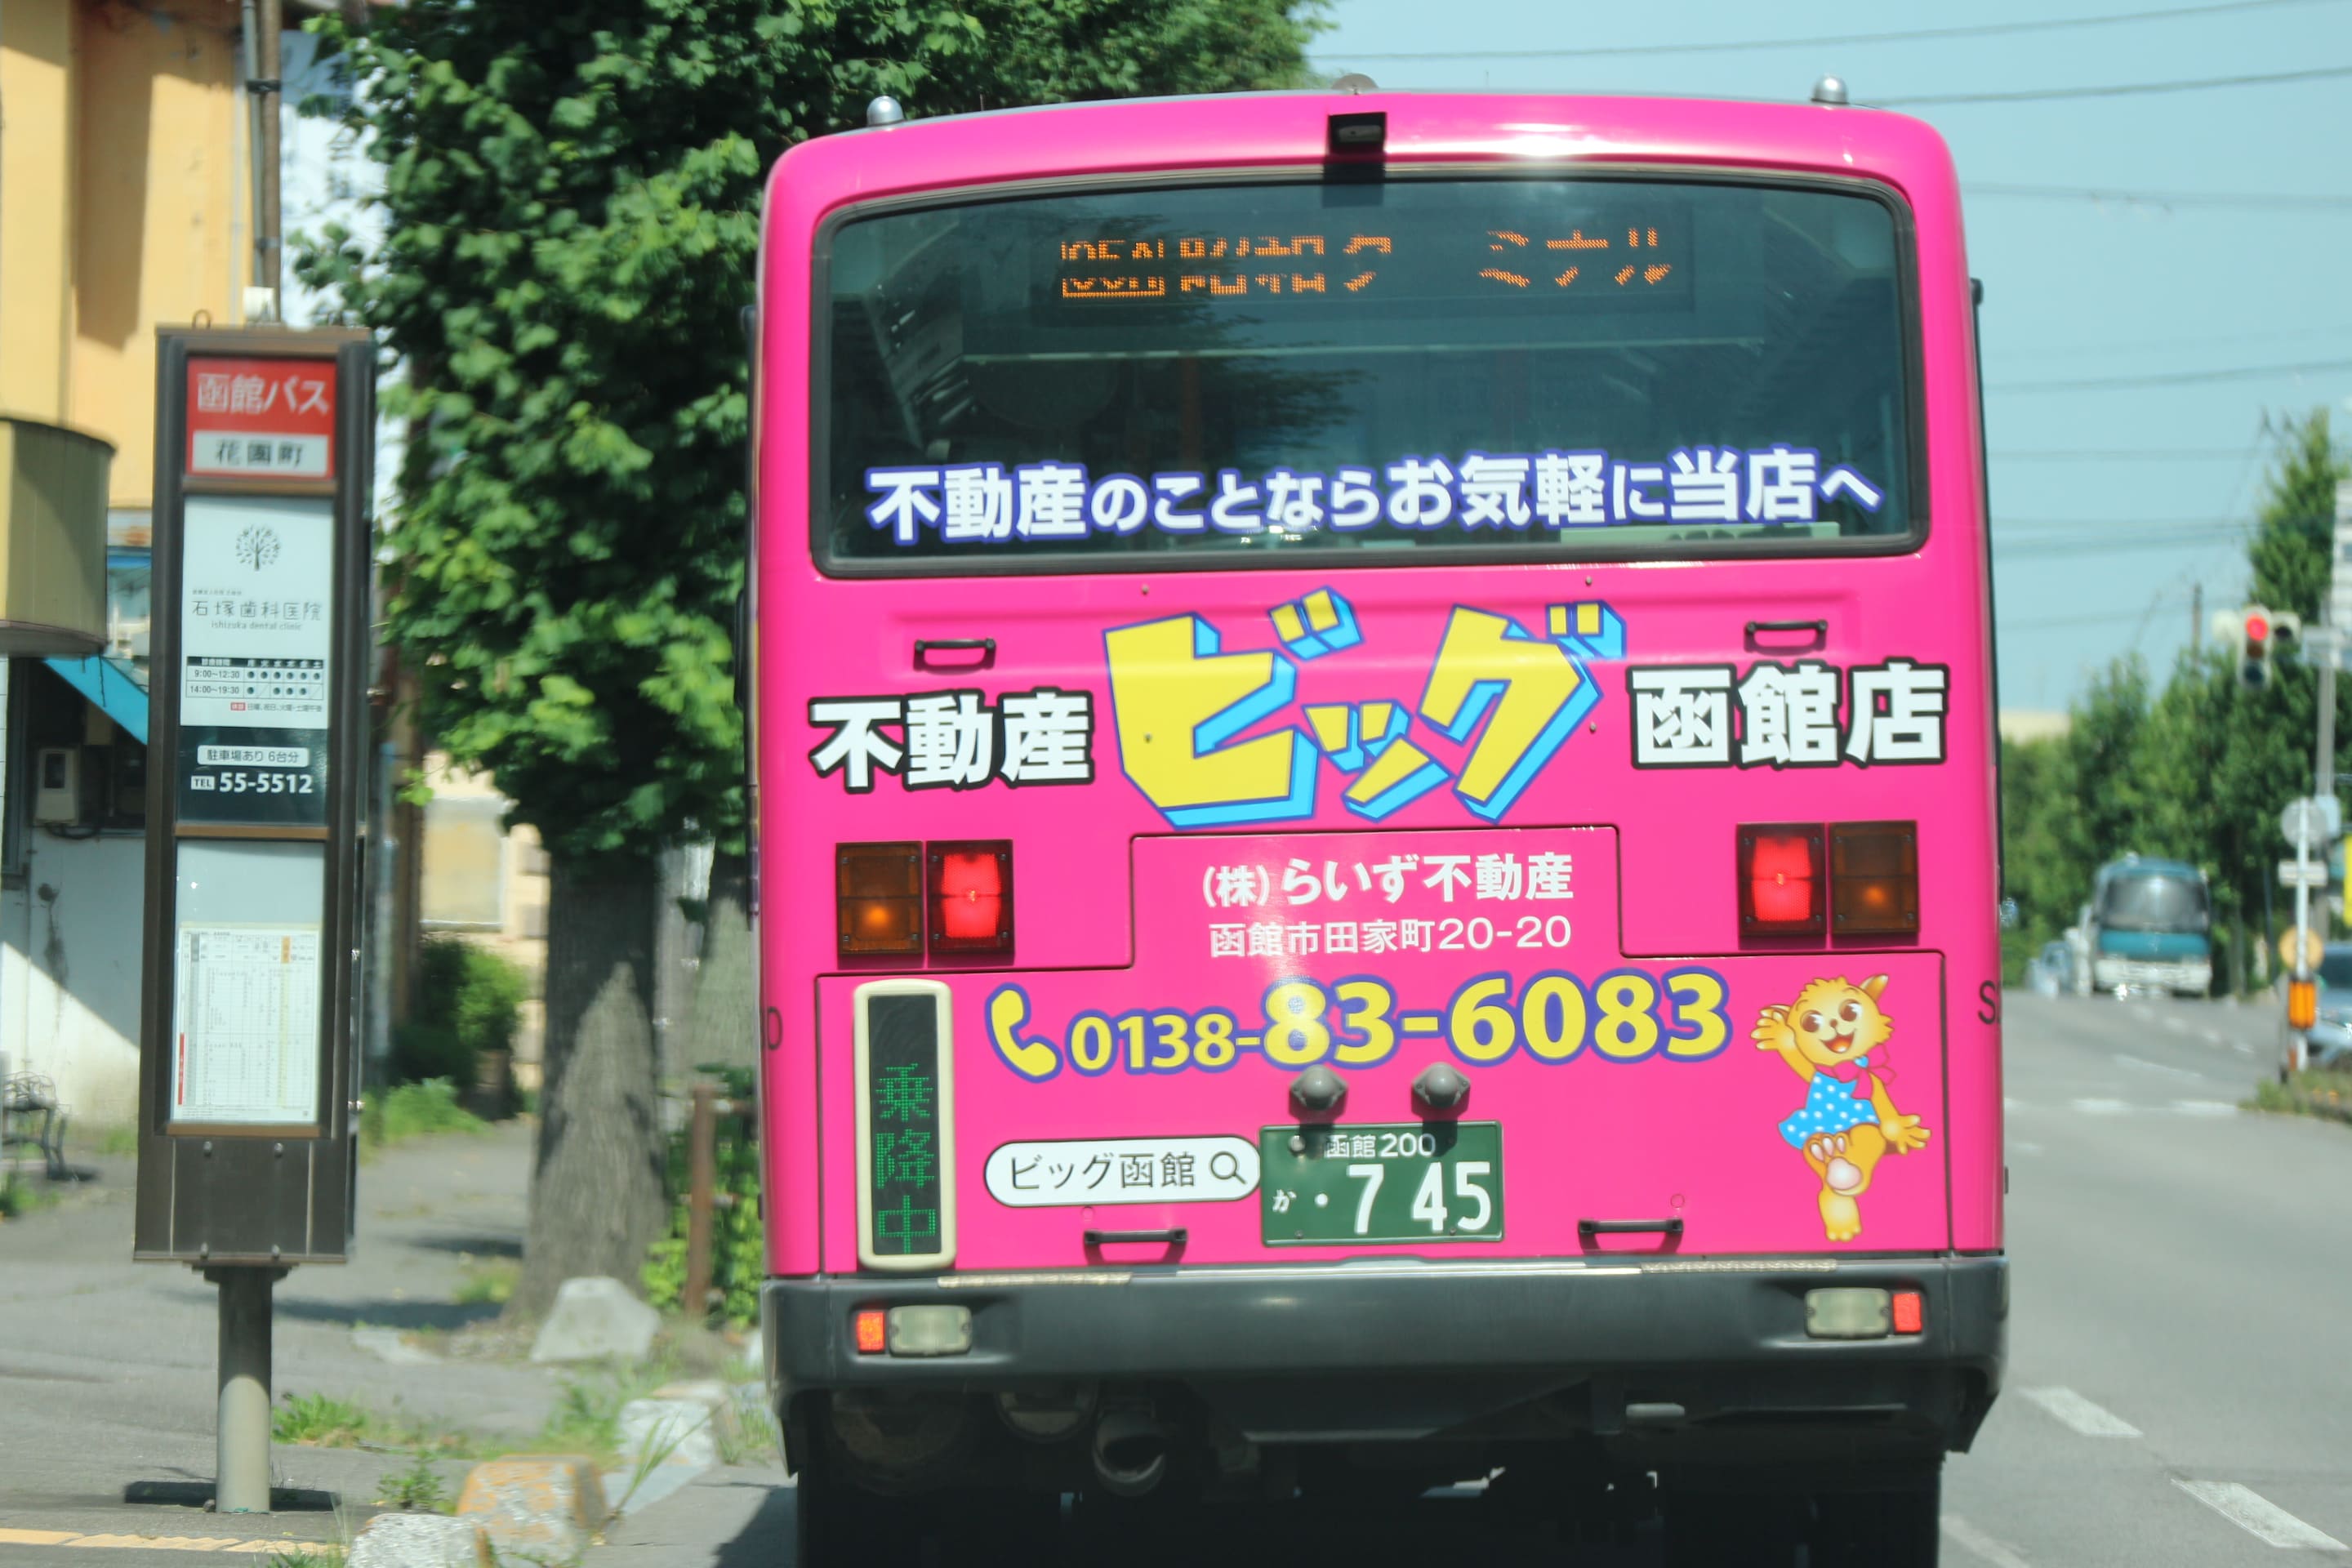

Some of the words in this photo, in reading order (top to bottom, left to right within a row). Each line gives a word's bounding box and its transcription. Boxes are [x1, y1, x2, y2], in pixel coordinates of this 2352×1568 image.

[1180, 228, 1673, 295] 昭和タミナル
[197, 372, 328, 414] 函館バス
[216, 439, 303, 467] 花園町
[868, 446, 1880, 543] 不動産のことならお気軽に当店へ
[192, 601, 322, 621] 石塚歯科医院
[212, 621, 246, 629] ishizuka
[249, 621, 277, 630] dental
[279, 622, 301, 630] clinic
[808, 687, 1094, 793] 不動産
[1102, 585, 1626, 830] ビッグ
[1626, 657, 1948, 771] 函館店
[207, 749, 263, 762] 駐車場あり
[268, 751, 299, 763] 6台分
[194, 778, 212, 787] TEL
[219, 772, 313, 793] 55-5512
[1209, 915, 1571, 957] 函館市田家町20-20
[1068, 972, 1730, 1074] 0138-83-6083
[875, 1063, 936, 1254] 乗降中
[1010, 1151, 1196, 1191] ビッグ函館
[1272, 1189, 1297, 1213] か
